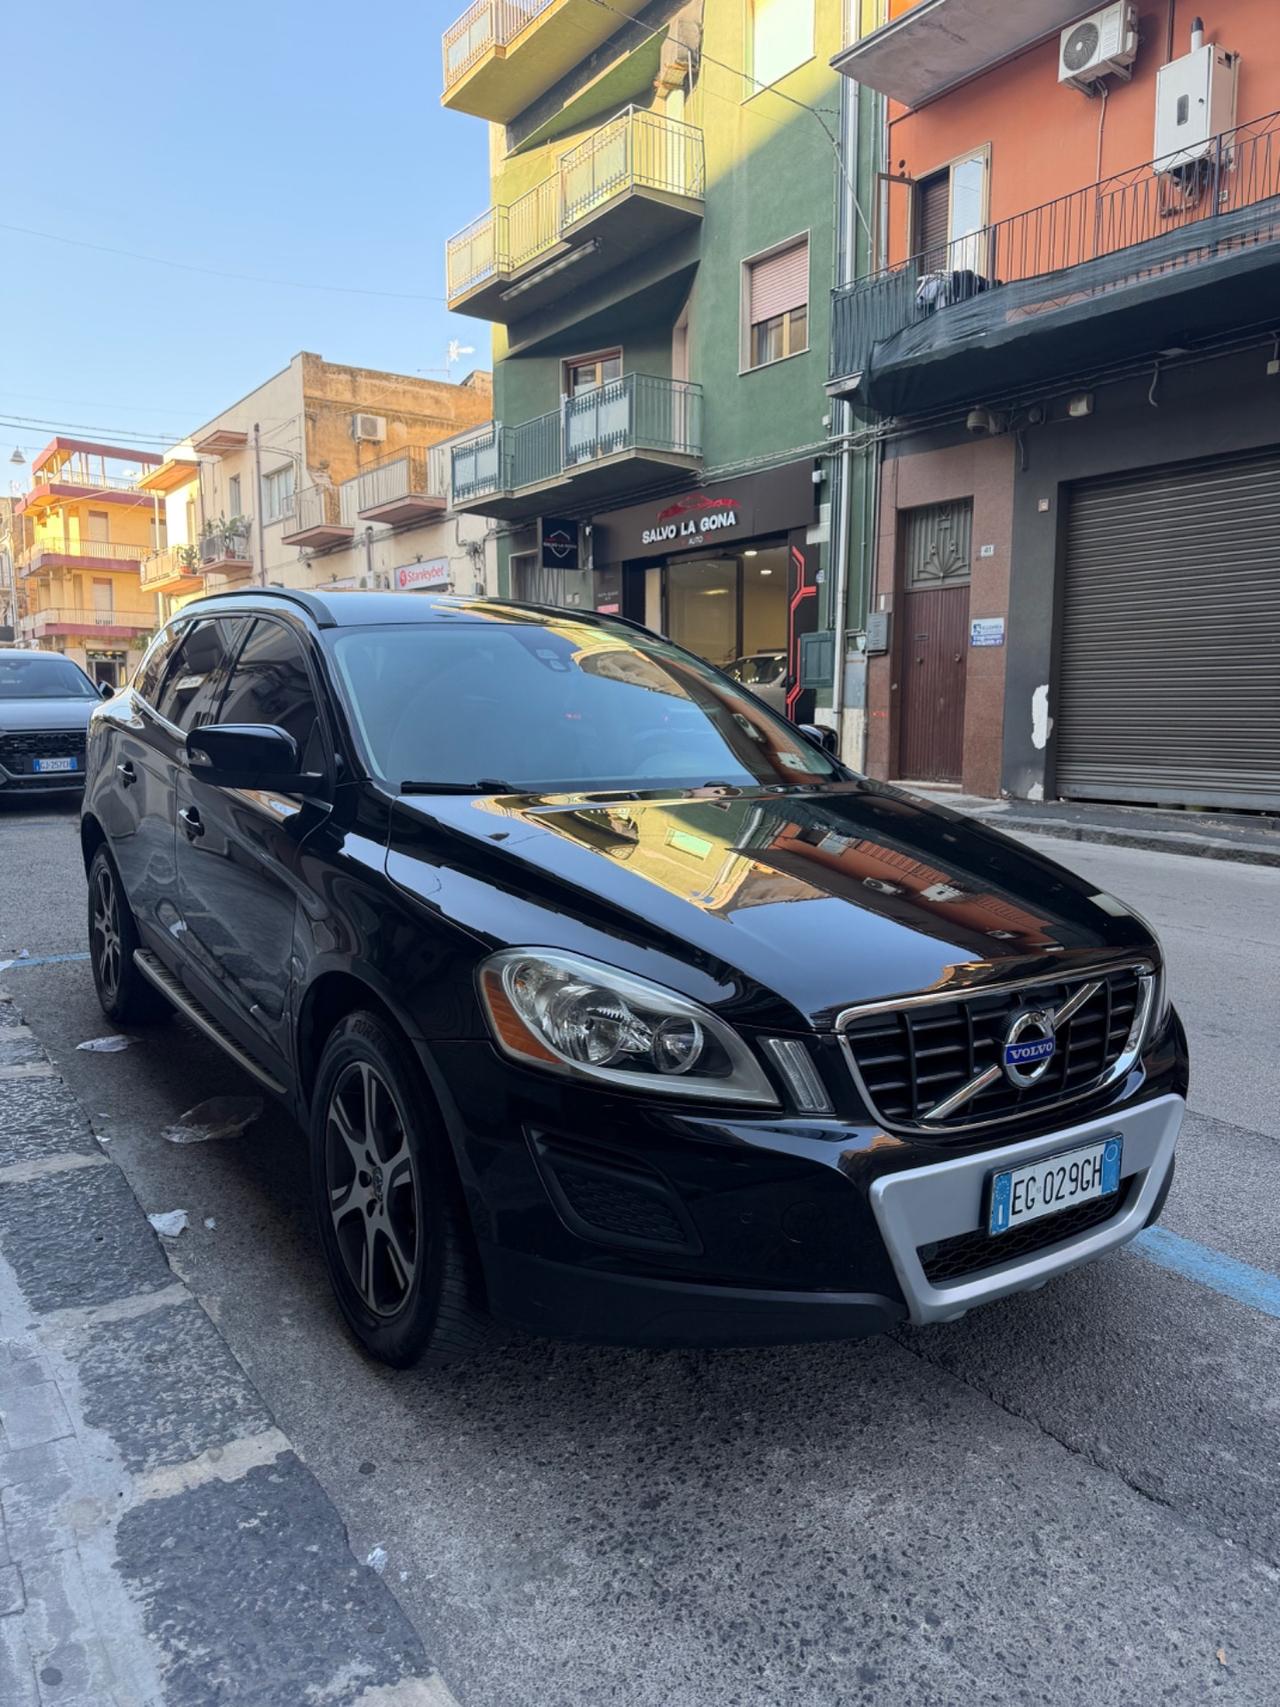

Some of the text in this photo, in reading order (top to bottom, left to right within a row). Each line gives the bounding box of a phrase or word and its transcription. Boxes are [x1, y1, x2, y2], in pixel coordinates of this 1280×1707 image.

[642, 511, 736, 544] SALVO LA GONA
[1010, 1042, 1053, 1060] VOLVO
